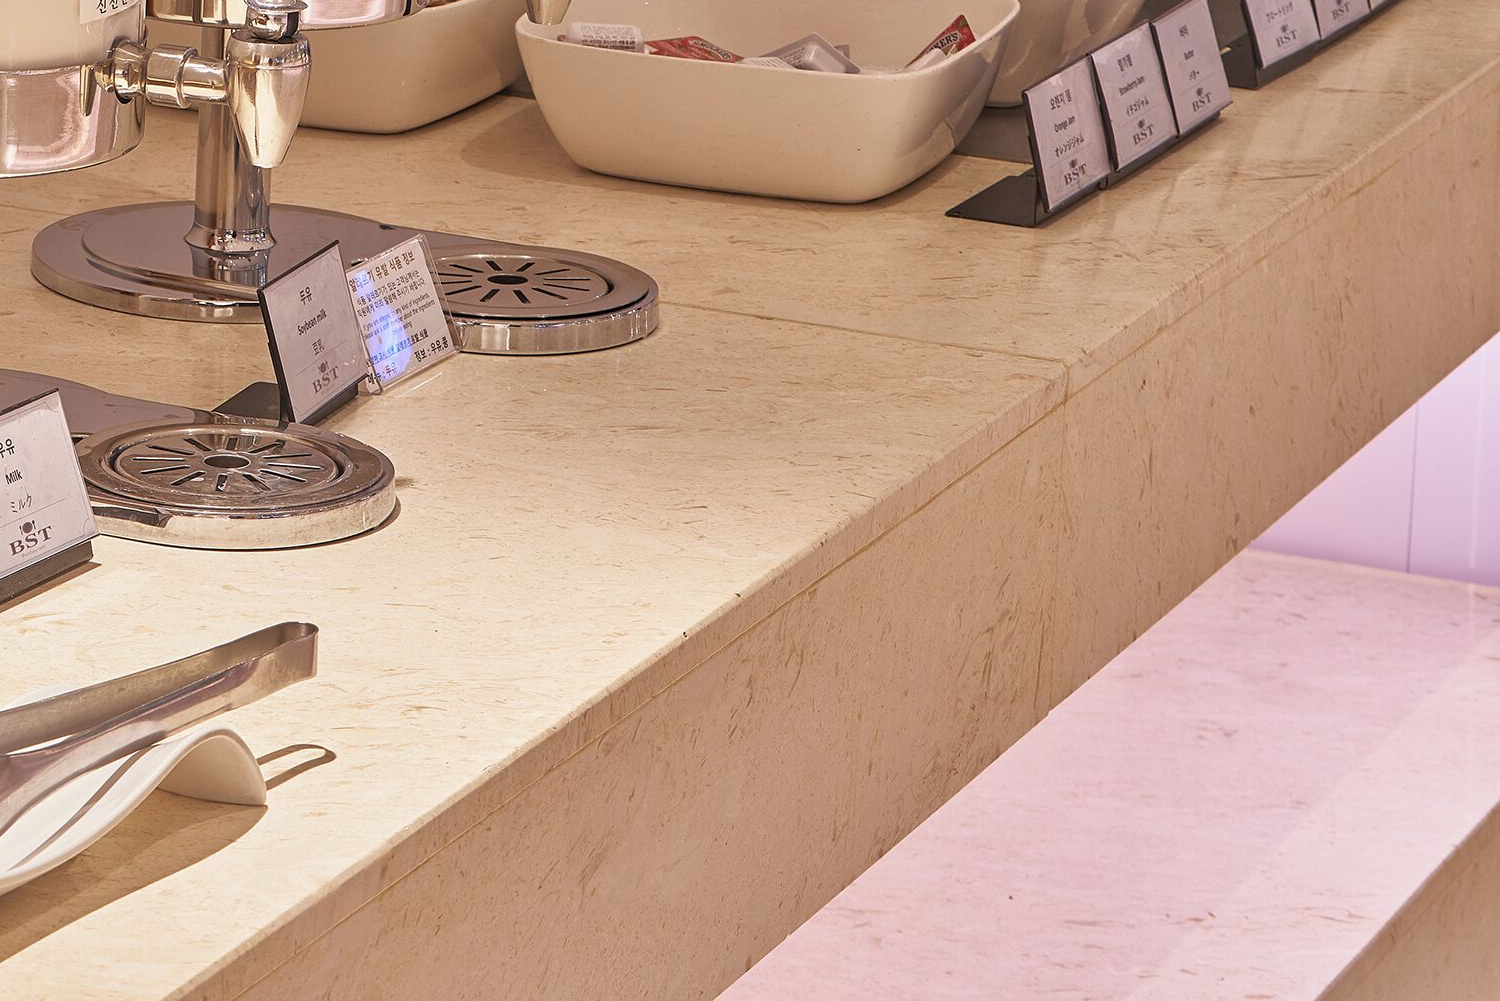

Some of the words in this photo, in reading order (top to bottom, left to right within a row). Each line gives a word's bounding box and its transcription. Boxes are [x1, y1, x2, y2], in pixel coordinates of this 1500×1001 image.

[1332, 2, 1350, 20] BST
[1276, 29, 1297, 47] BST
[1191, 92, 1212, 113] BST
[1132, 124, 1154, 145] BST
[1063, 164, 1087, 186] BST
[375, 262, 389, 279] 유발
[389, 256, 403, 271] 식품
[402, 251, 415, 266] 정보
[300, 286, 312, 306] 두유
[297, 317, 318, 336] Soybean
[414, 348, 427, 363] 정보
[312, 366, 339, 394] BST
[5, 469, 23, 486] Milk
[10, 494, 33, 513] ミルク
[9, 526, 52, 556] BST
